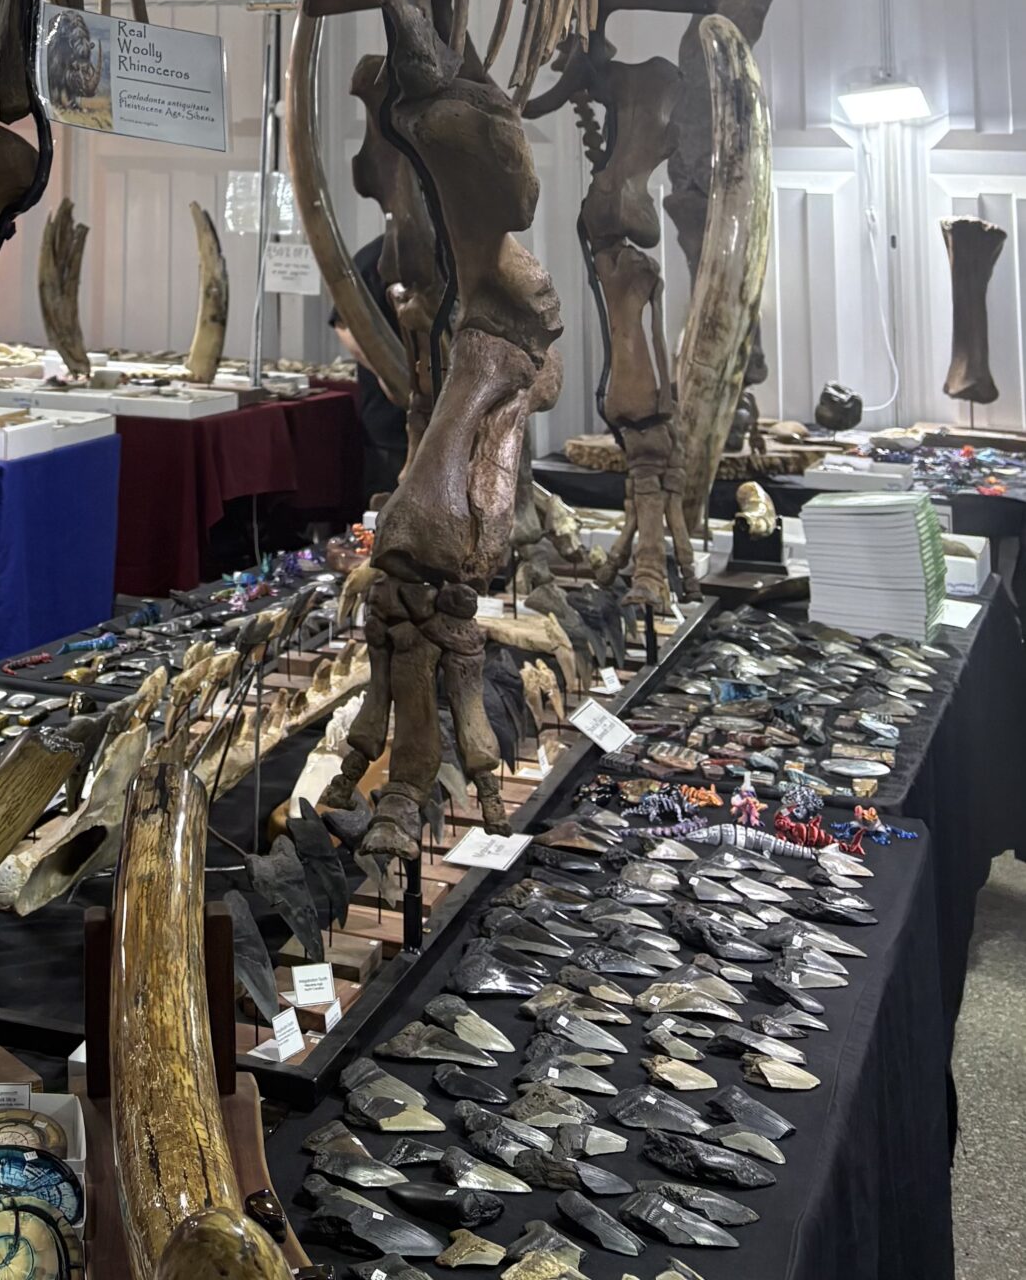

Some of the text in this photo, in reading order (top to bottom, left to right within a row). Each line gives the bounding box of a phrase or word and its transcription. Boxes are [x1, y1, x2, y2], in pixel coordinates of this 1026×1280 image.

[118, 21, 147, 39] Real
[117, 37, 162, 63] Woolly
[118, 55, 190, 80] Rhinoceros
[119, 89, 166, 105] Coelodonta
[119, 97, 163, 114] Pleistocene
[186, 109, 215, 123] Siberia
